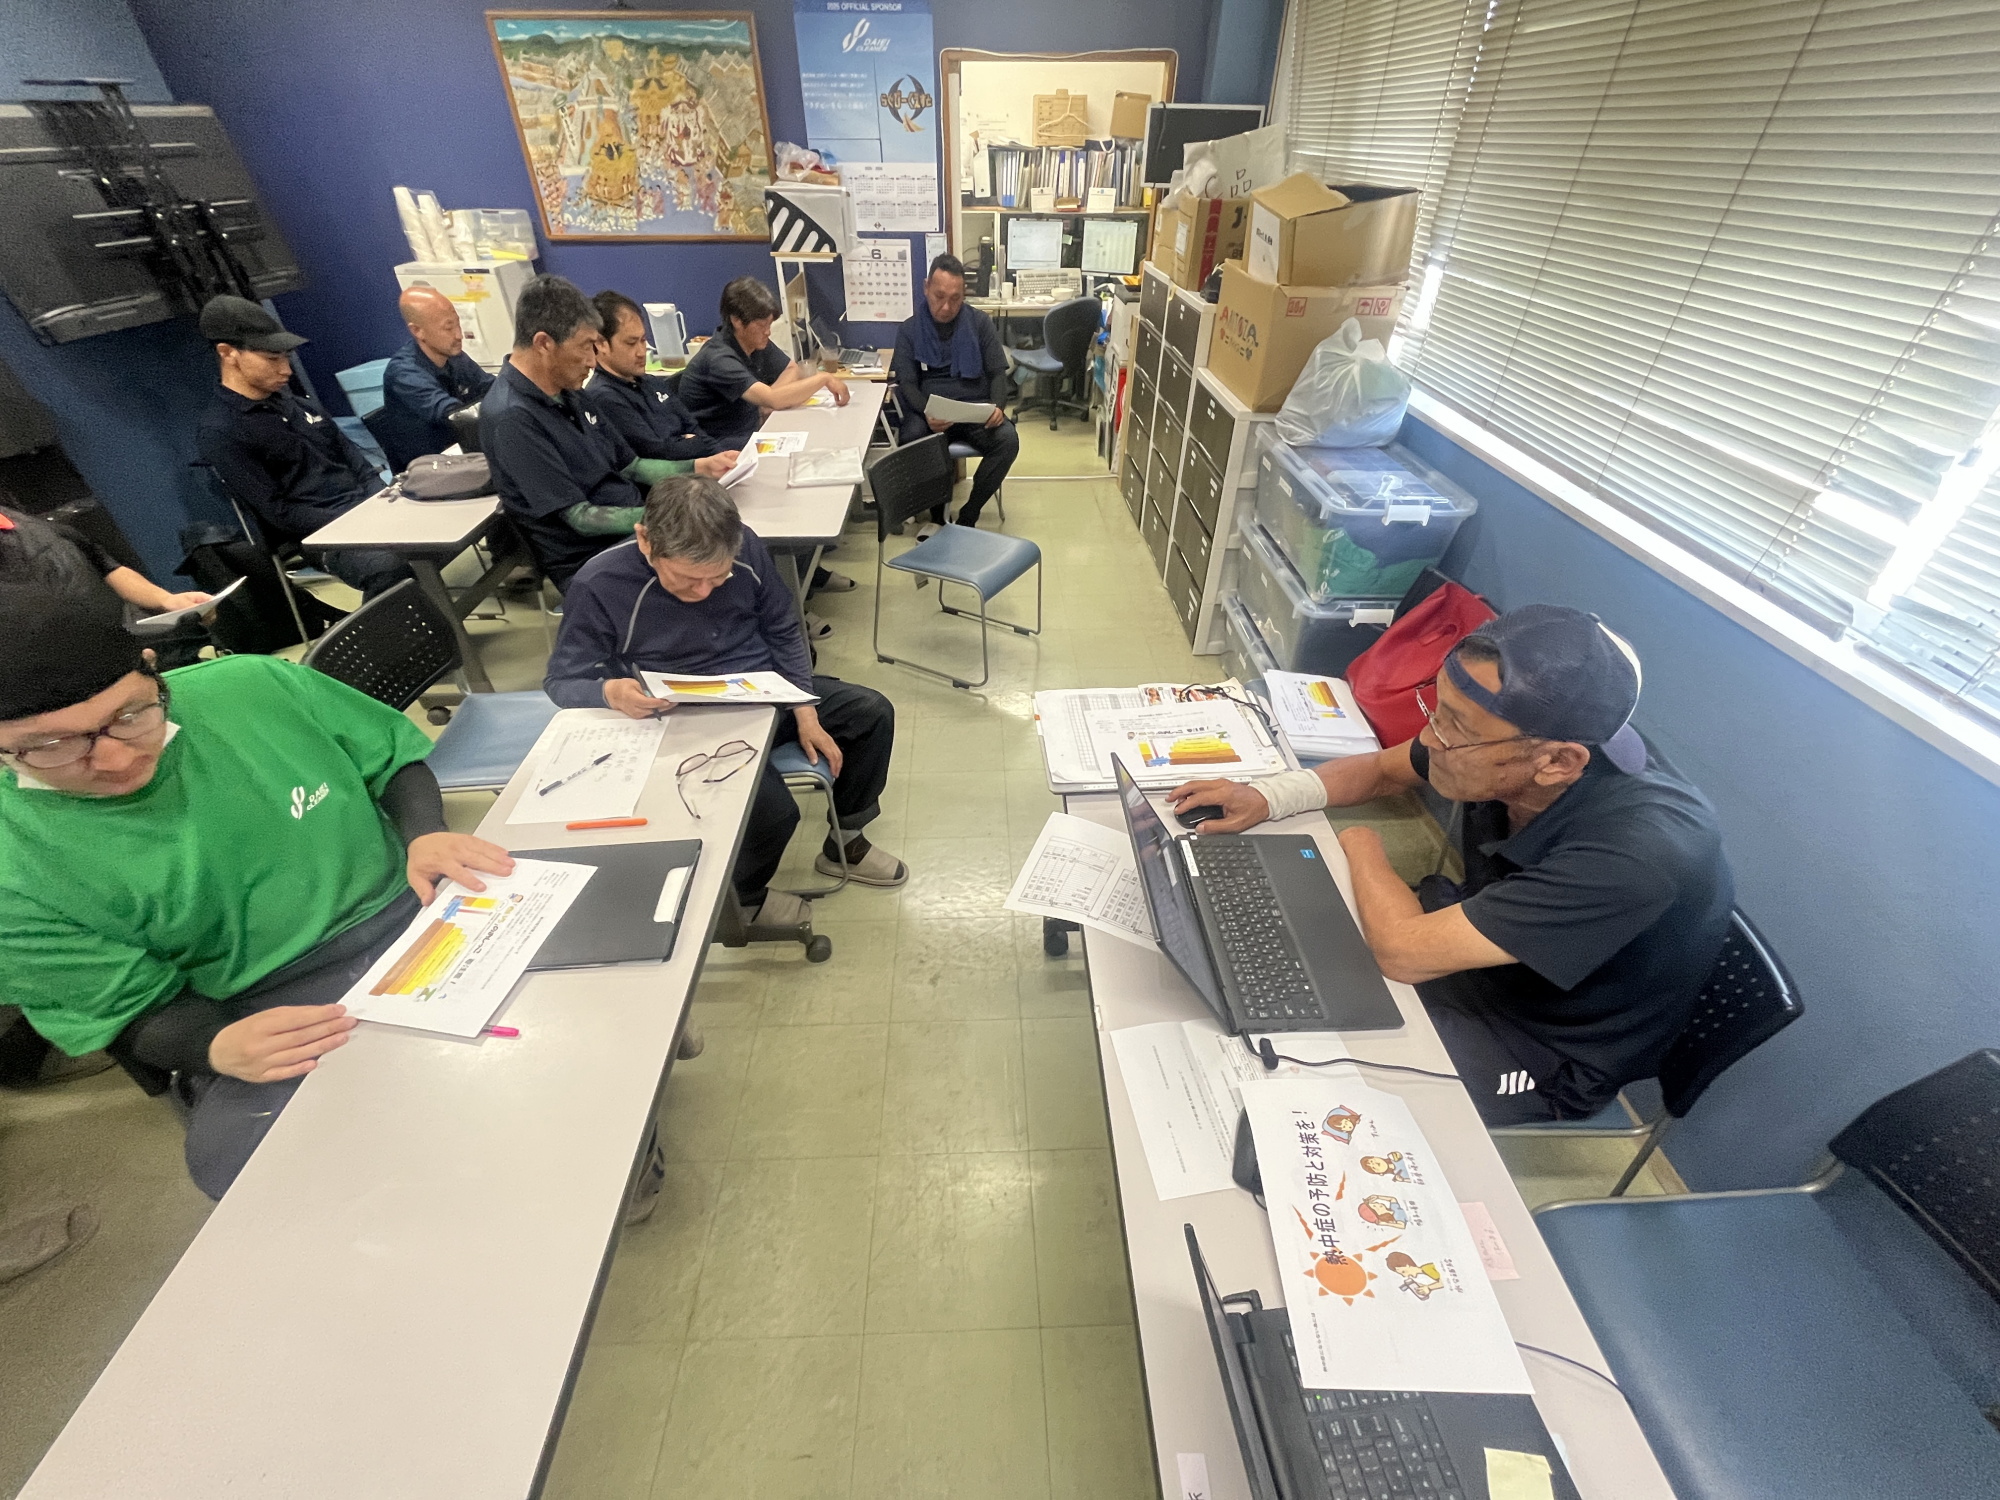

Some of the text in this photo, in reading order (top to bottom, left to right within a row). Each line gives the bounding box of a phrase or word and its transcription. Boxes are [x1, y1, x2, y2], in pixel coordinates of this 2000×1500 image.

[841, 2, 870, 10] OFFICIAL
[871, 3, 902, 11] SPONSOR
[871, 249, 881, 259] 6
